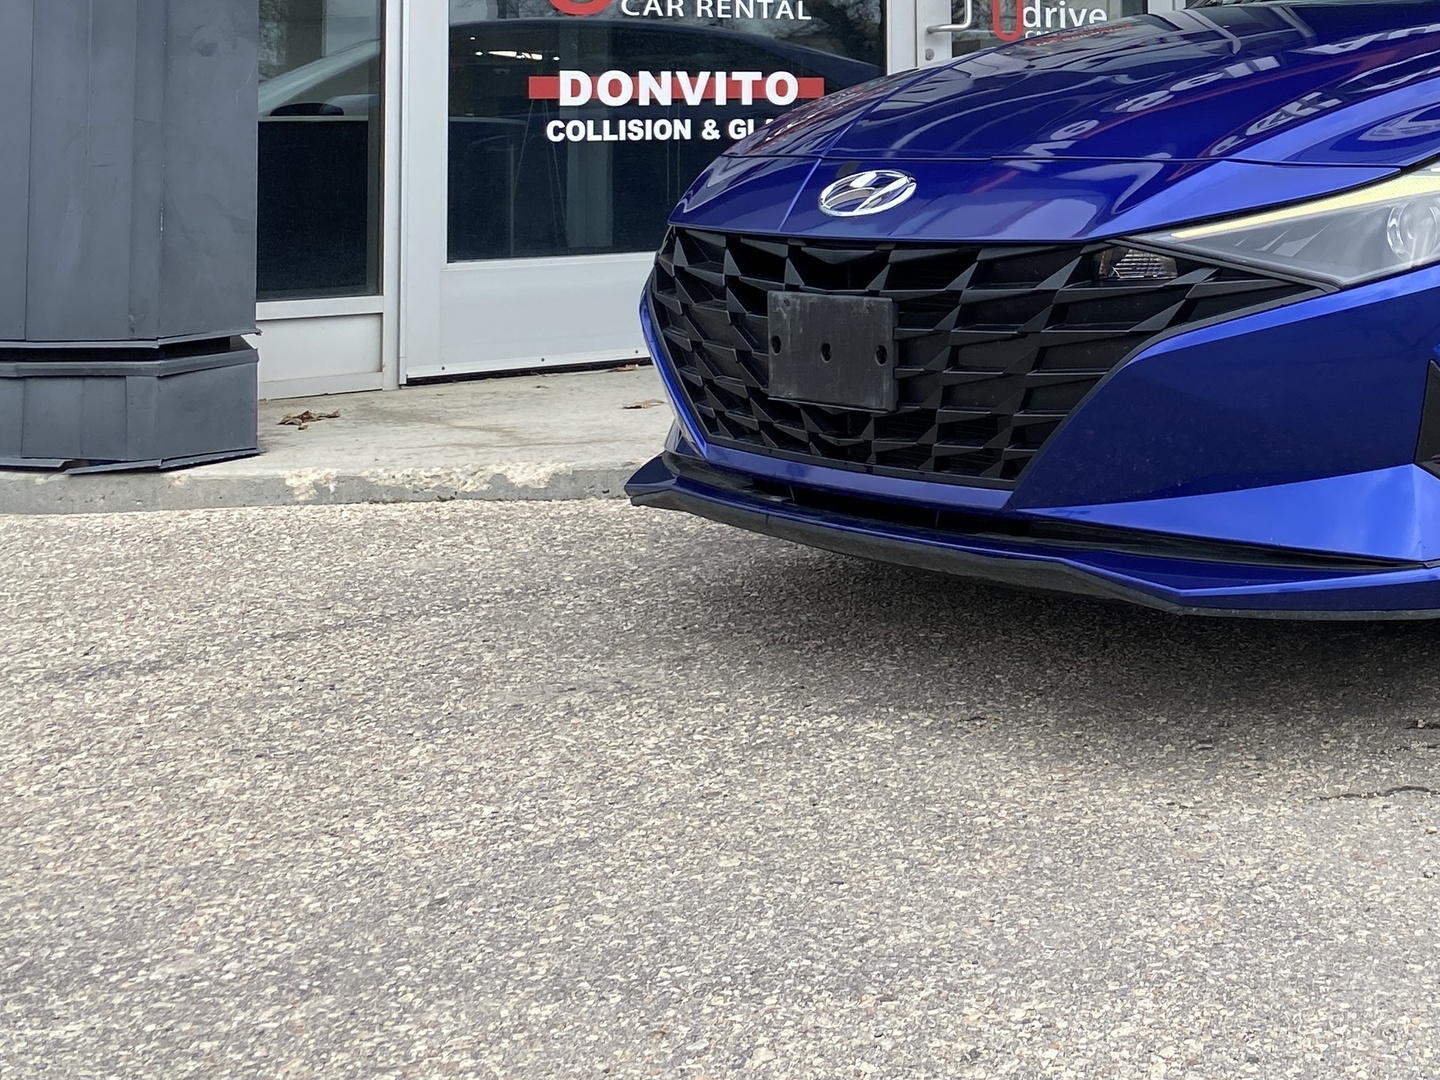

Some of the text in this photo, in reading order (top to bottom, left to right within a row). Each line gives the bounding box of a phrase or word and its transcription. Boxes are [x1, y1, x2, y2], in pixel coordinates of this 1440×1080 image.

[558, 69, 800, 107] DONVITO
[546, 118, 692, 143] COLLISION
[701, 118, 721, 140] &
